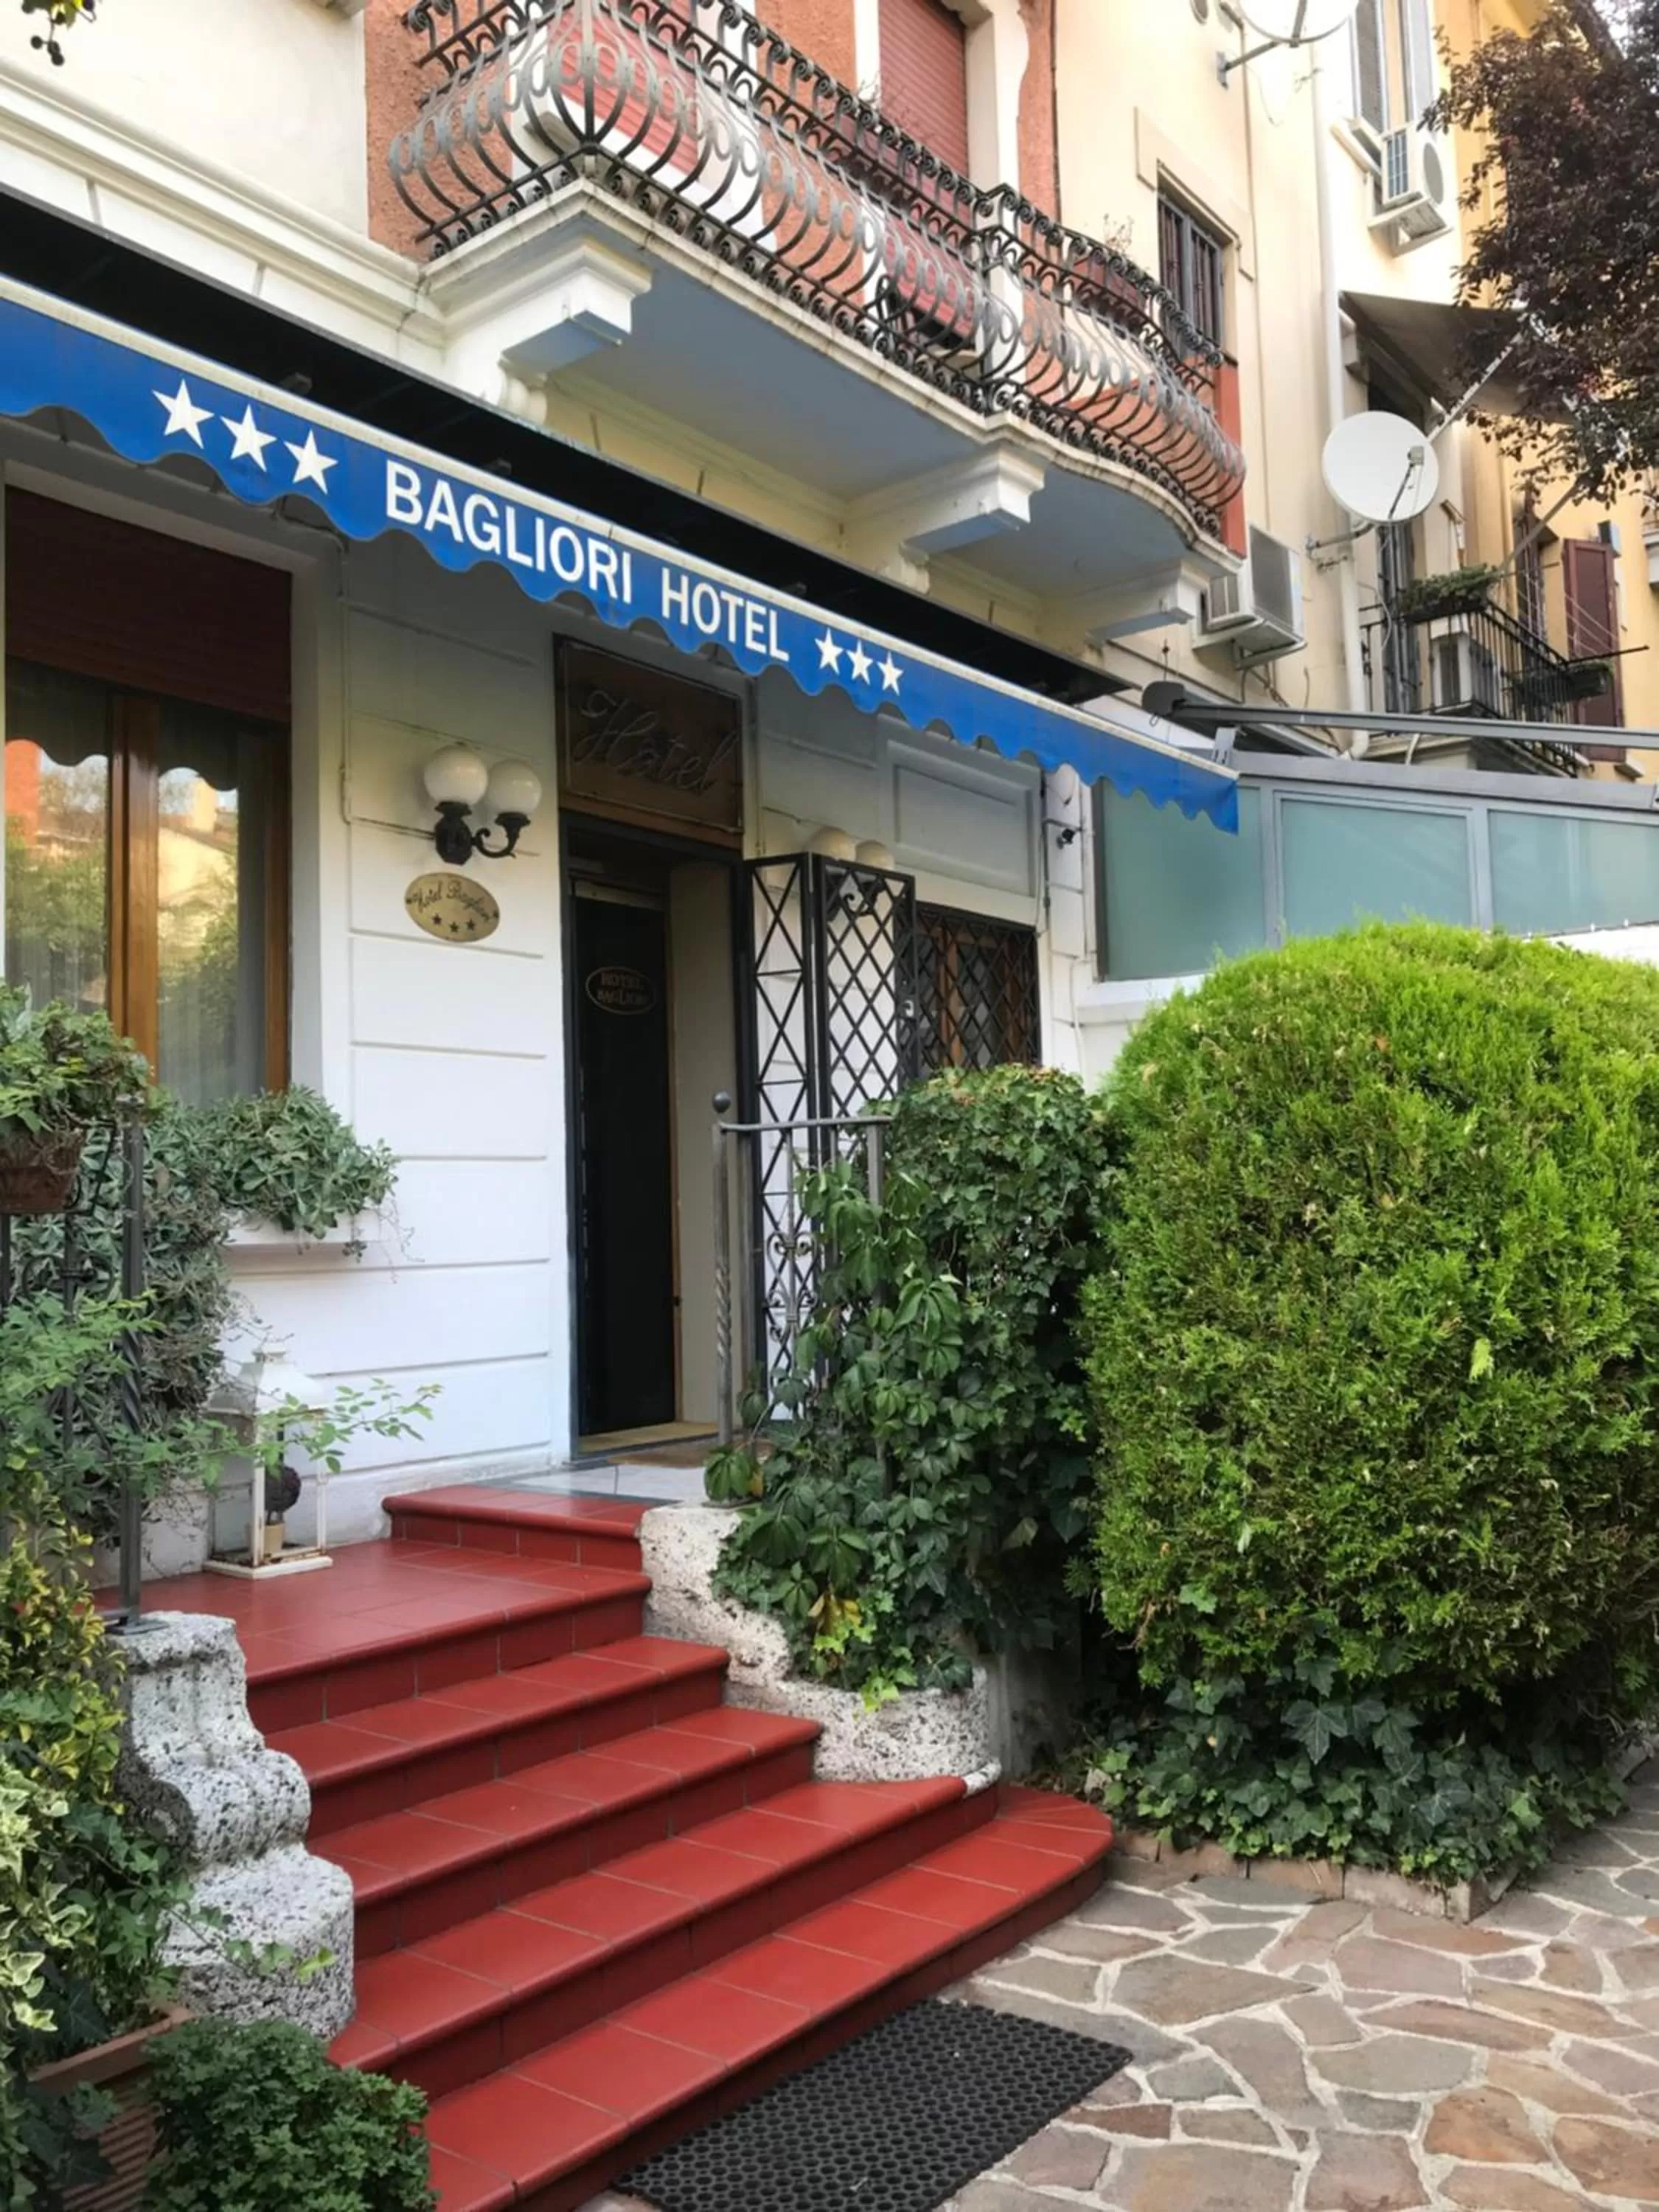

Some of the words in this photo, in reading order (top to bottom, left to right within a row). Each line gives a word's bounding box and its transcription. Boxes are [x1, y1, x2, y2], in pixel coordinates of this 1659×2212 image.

[386, 460, 632, 604] BAGLIORI
[661, 568, 790, 661] HOTEL
[572, 689, 740, 790] Hotel
